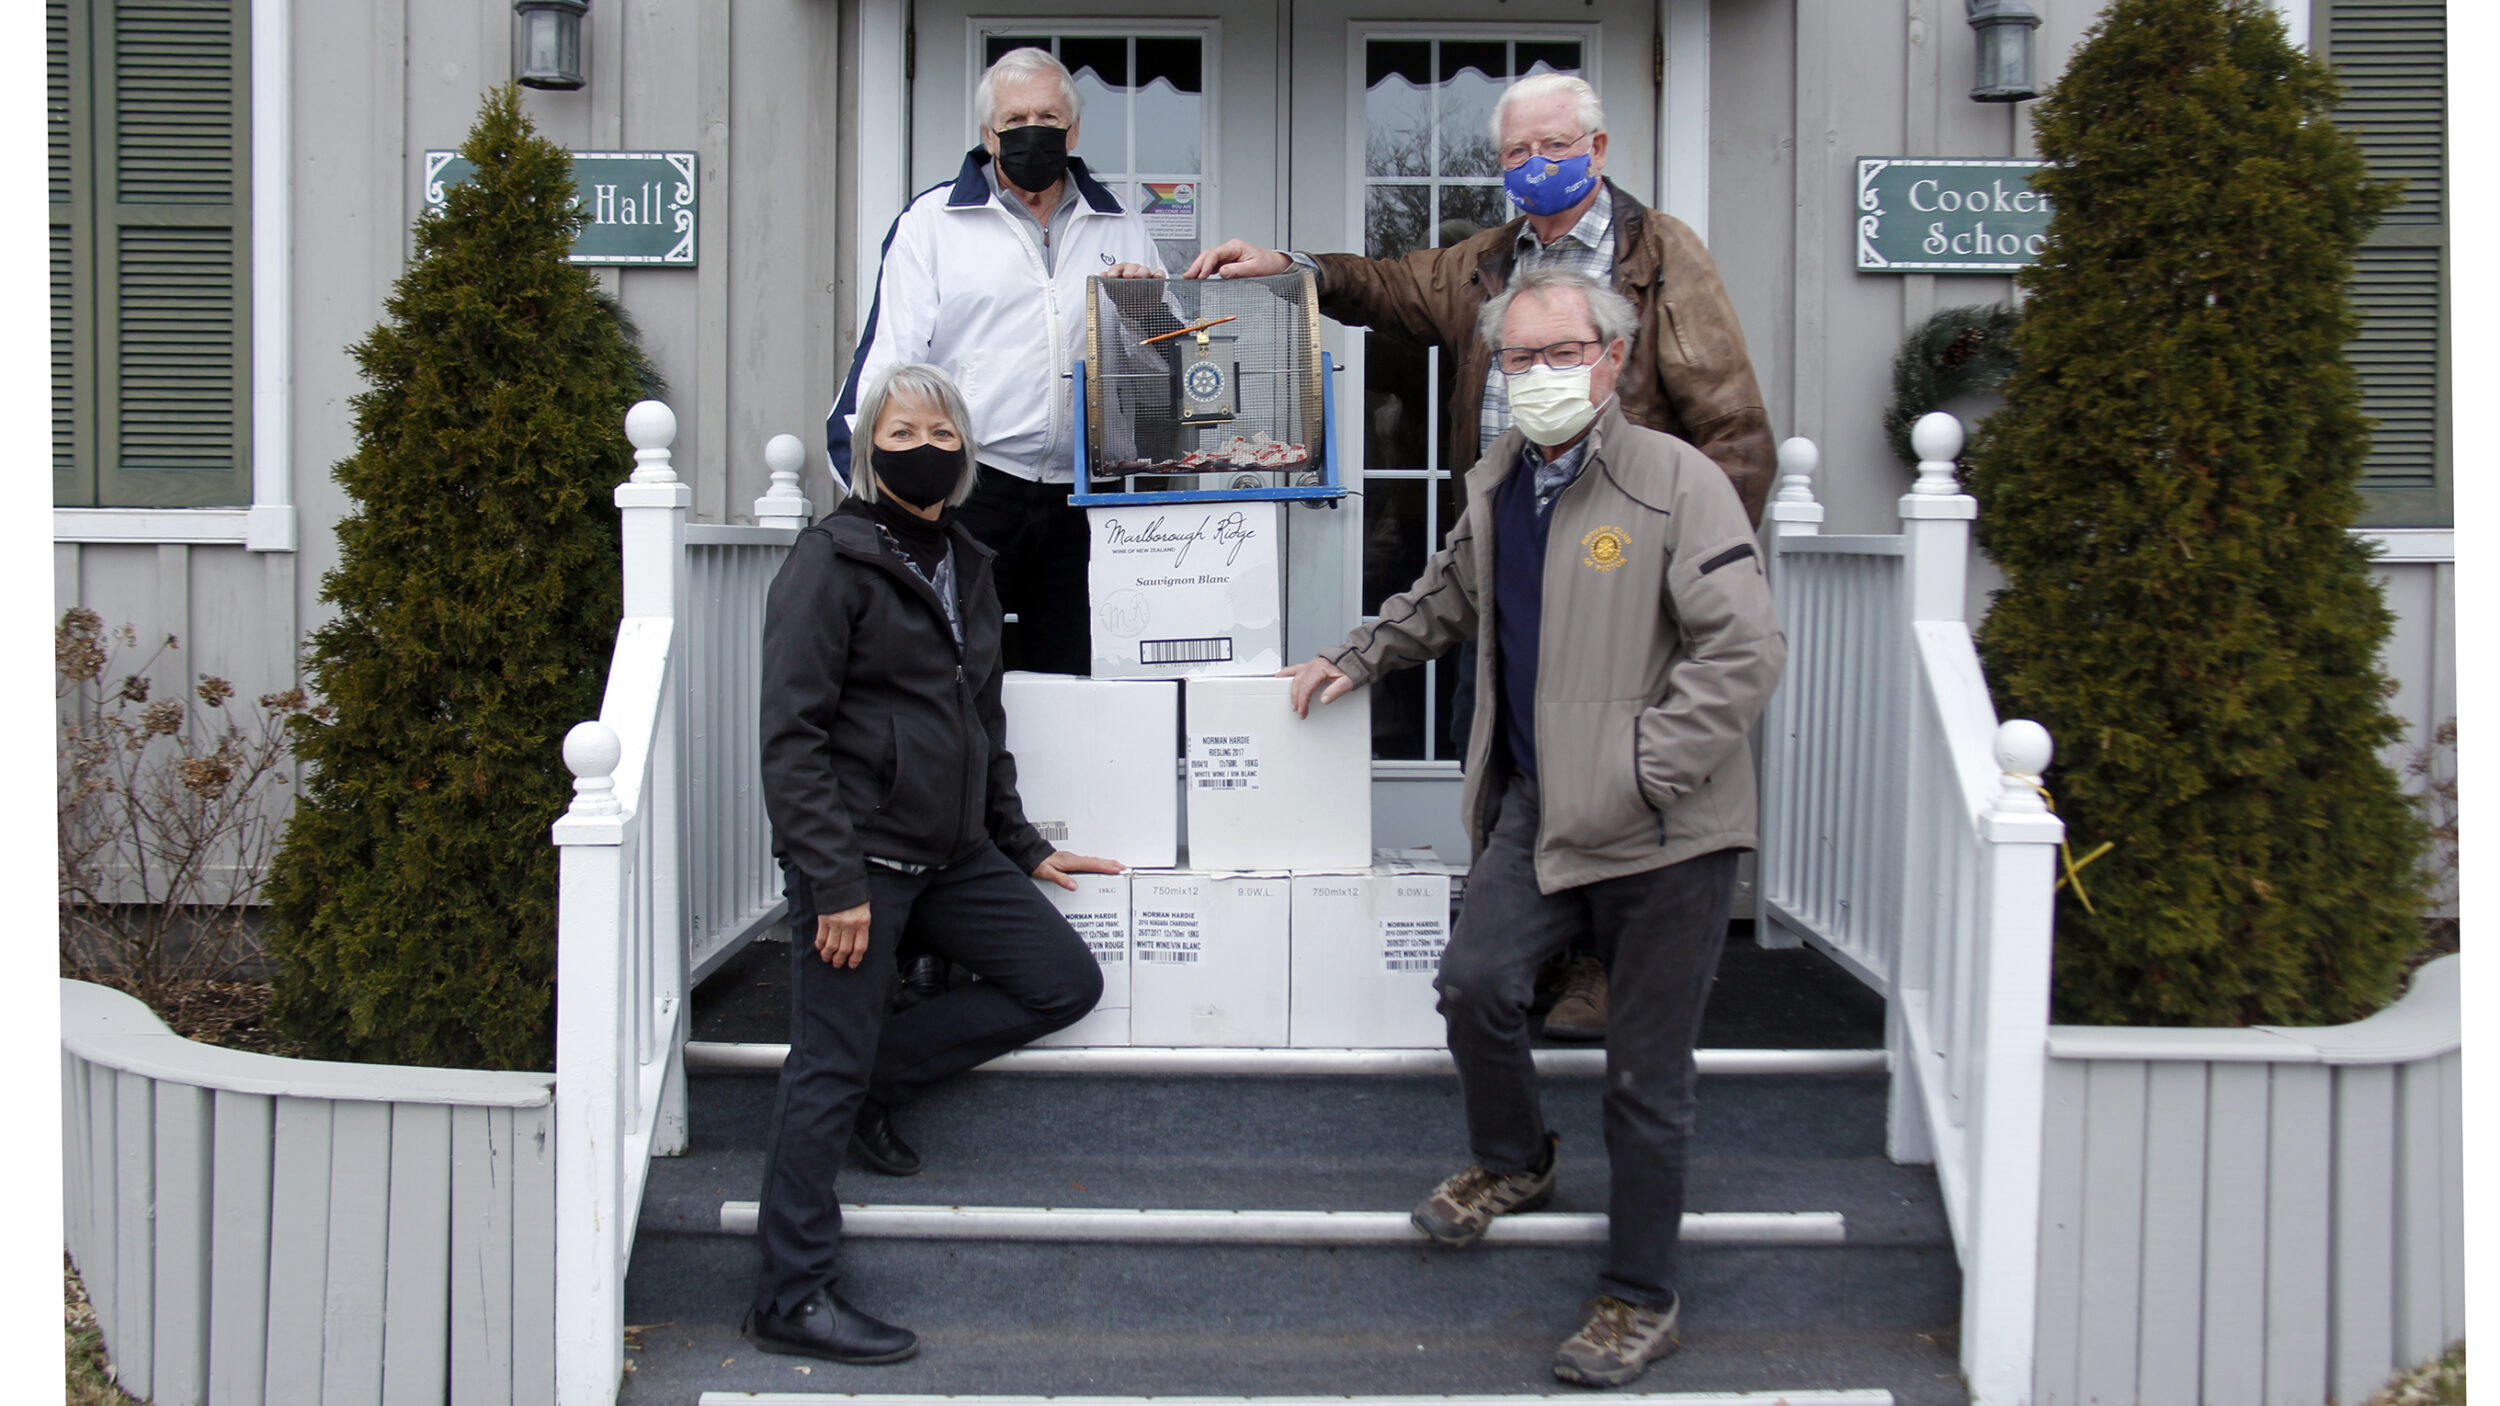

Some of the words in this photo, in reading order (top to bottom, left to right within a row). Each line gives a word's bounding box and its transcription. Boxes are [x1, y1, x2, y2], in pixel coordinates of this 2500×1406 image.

[1908, 178, 2054, 212] Cooker
[594, 181, 664, 225] Hall
[1105, 515, 1211, 568] Marlborough
[1213, 511, 1257, 566] Ridge
[1136, 576, 1195, 586] Sauvignon
[1198, 574, 1230, 584] Blanc
[1202, 736, 1228, 744] NORMAN
[1229, 736, 1250, 744] HARDIE
[1209, 748, 1231, 756] RIESLING
[1232, 748, 1244, 756] 2017
[1244, 759, 1259, 767] 18KG
[1112, 930, 1124, 938] 18KG
[1187, 930, 1200, 938] 18KG
[1105, 941, 1124, 949] ROUGE
[1136, 940, 1154, 949] WHITE
[1182, 941, 1201, 950] BLANC
[1384, 950, 1402, 958] WHITE
